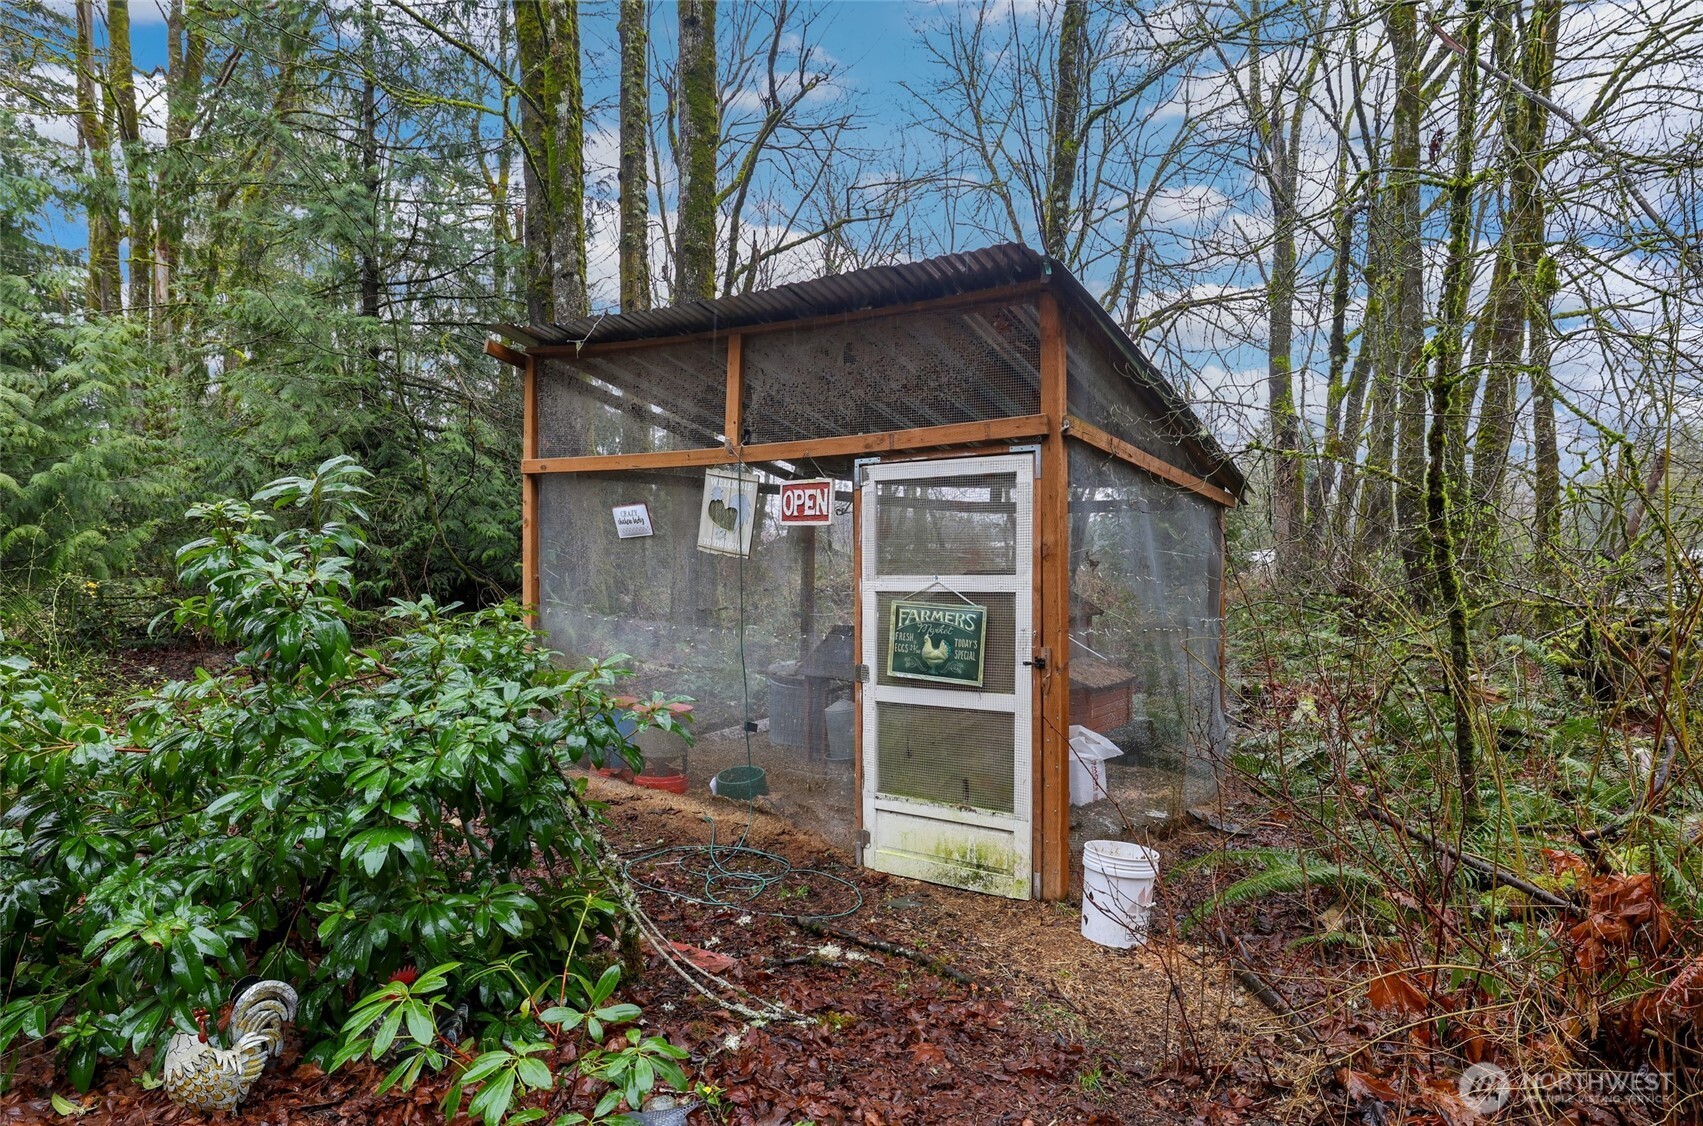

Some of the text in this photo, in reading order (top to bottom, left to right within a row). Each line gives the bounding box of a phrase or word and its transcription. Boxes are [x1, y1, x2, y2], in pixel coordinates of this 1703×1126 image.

[711, 477, 753, 491] WELCOME
[782, 488, 829, 516] OPEN
[633, 516, 645, 525] lady
[898, 608, 977, 631] FARMERS
[917, 622, 954, 637] Market
[895, 632, 914, 641] FRESH
[894, 643, 909, 653] EGGS
[954, 638, 978, 649] TODAY'S
[954, 649, 976, 661] SPECIAL
